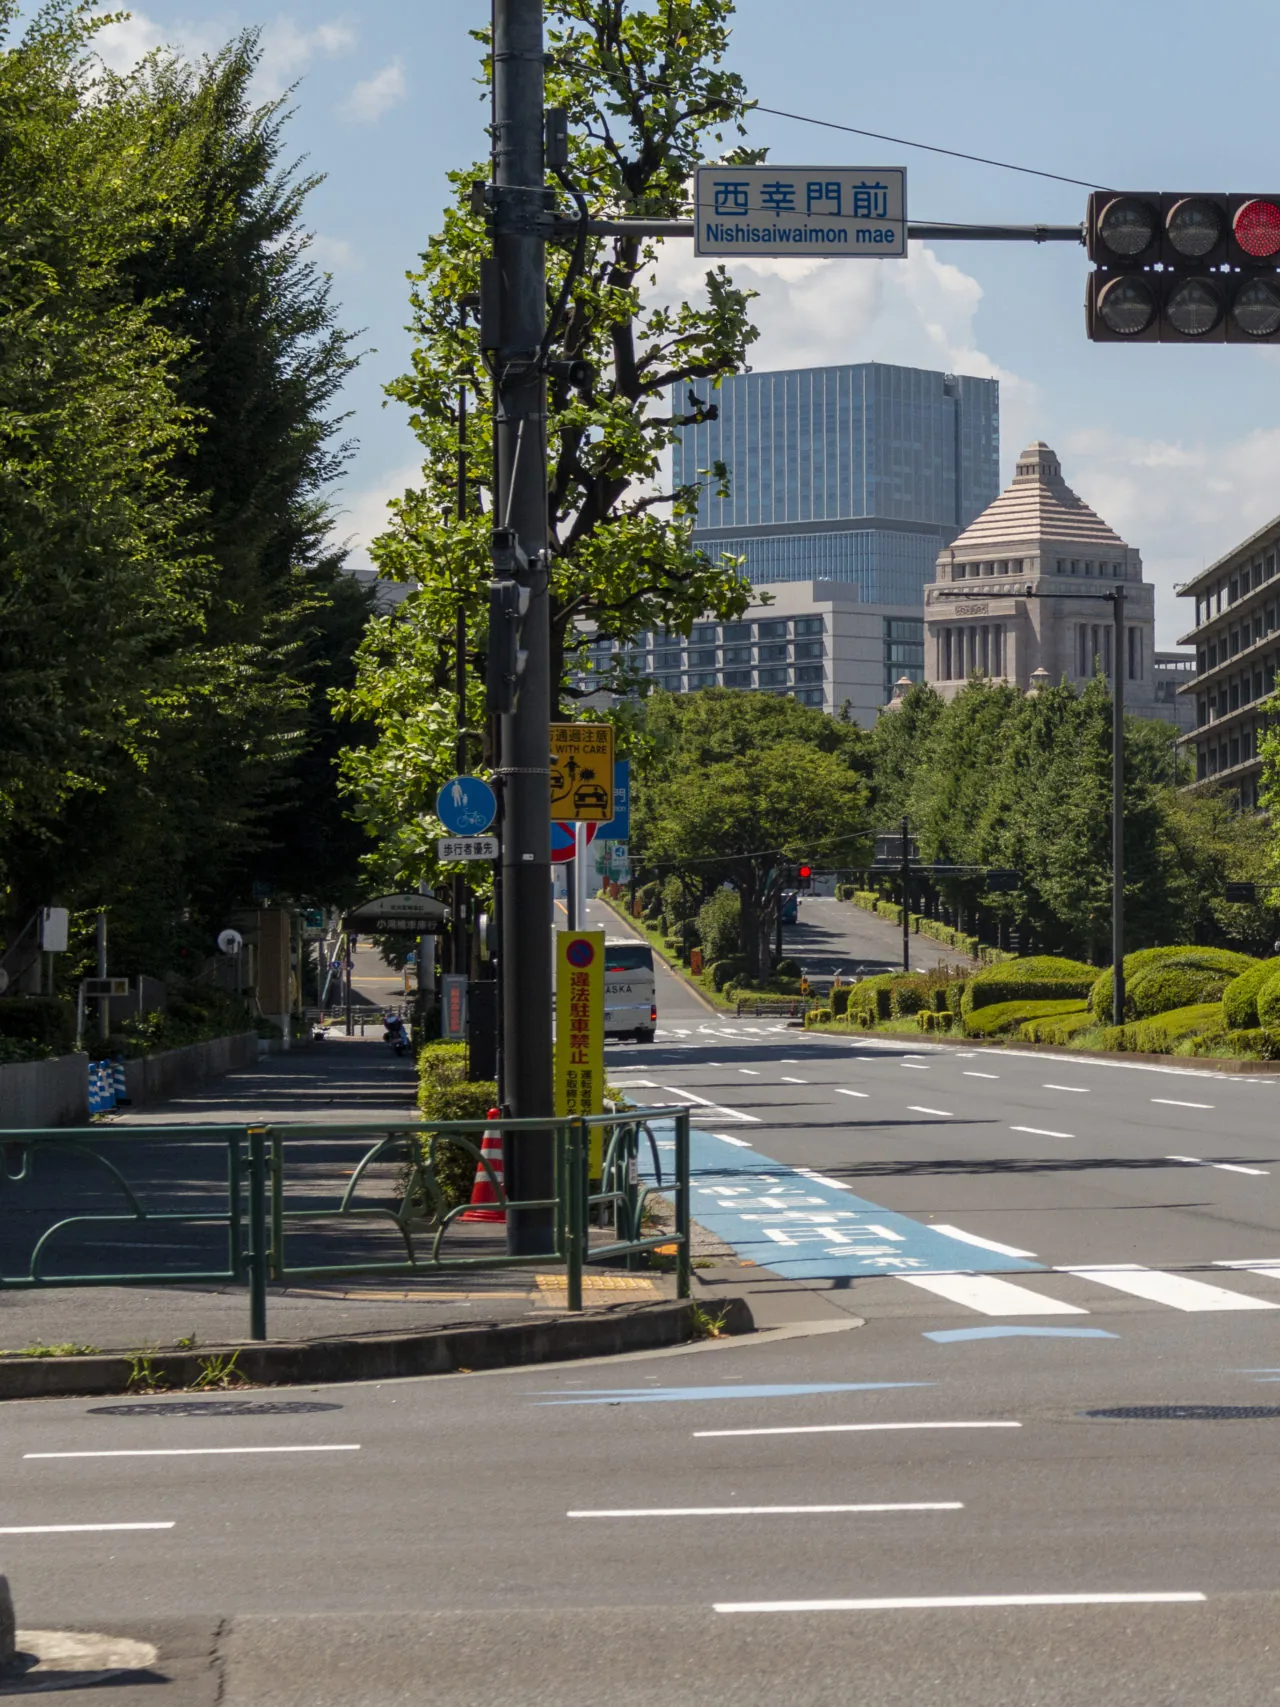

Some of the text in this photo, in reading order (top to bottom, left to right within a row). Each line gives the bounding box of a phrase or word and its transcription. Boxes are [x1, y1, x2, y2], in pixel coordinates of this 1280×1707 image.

[713, 181, 889, 218] 西幸門前
[706, 223, 895, 244] Nishisaiwaimon mae
[556, 744, 581, 755] WITH
[583, 744, 607, 755] CARE
[443, 842, 494, 857] 歩行者優先
[569, 971, 591, 1065] 違法駐車禁止
